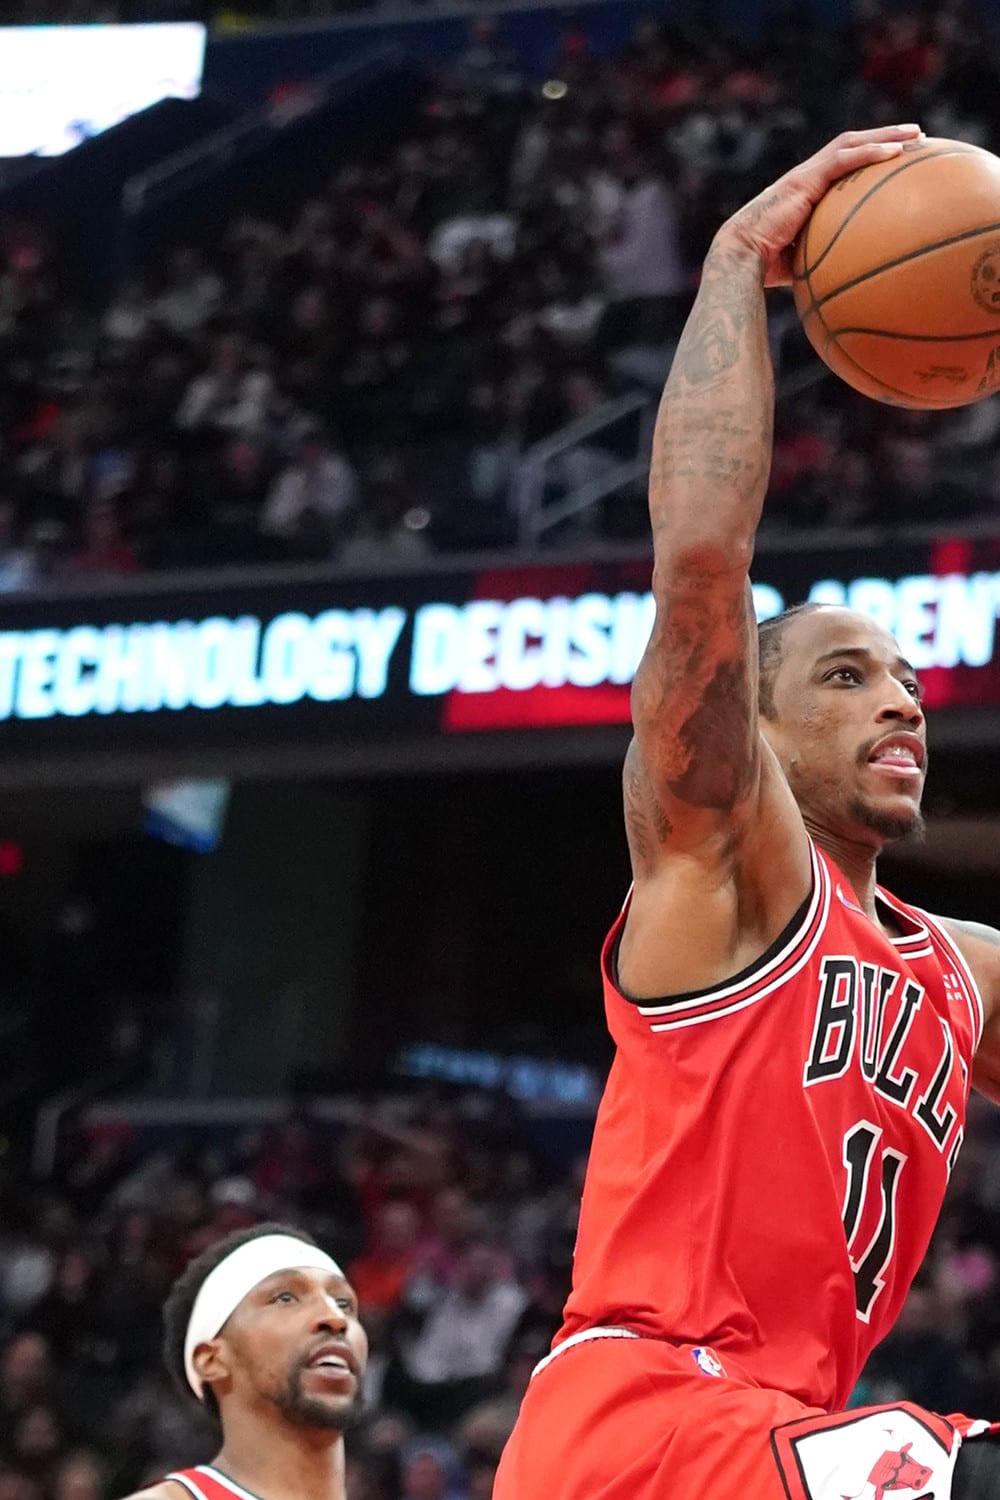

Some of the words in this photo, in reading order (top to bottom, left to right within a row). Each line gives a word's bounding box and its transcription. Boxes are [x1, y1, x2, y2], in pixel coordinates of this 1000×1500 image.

[0, 606, 407, 721] TECHNOLOGY
[409, 583, 784, 695] DECISI
[841, 1119, 908, 1325] 11
